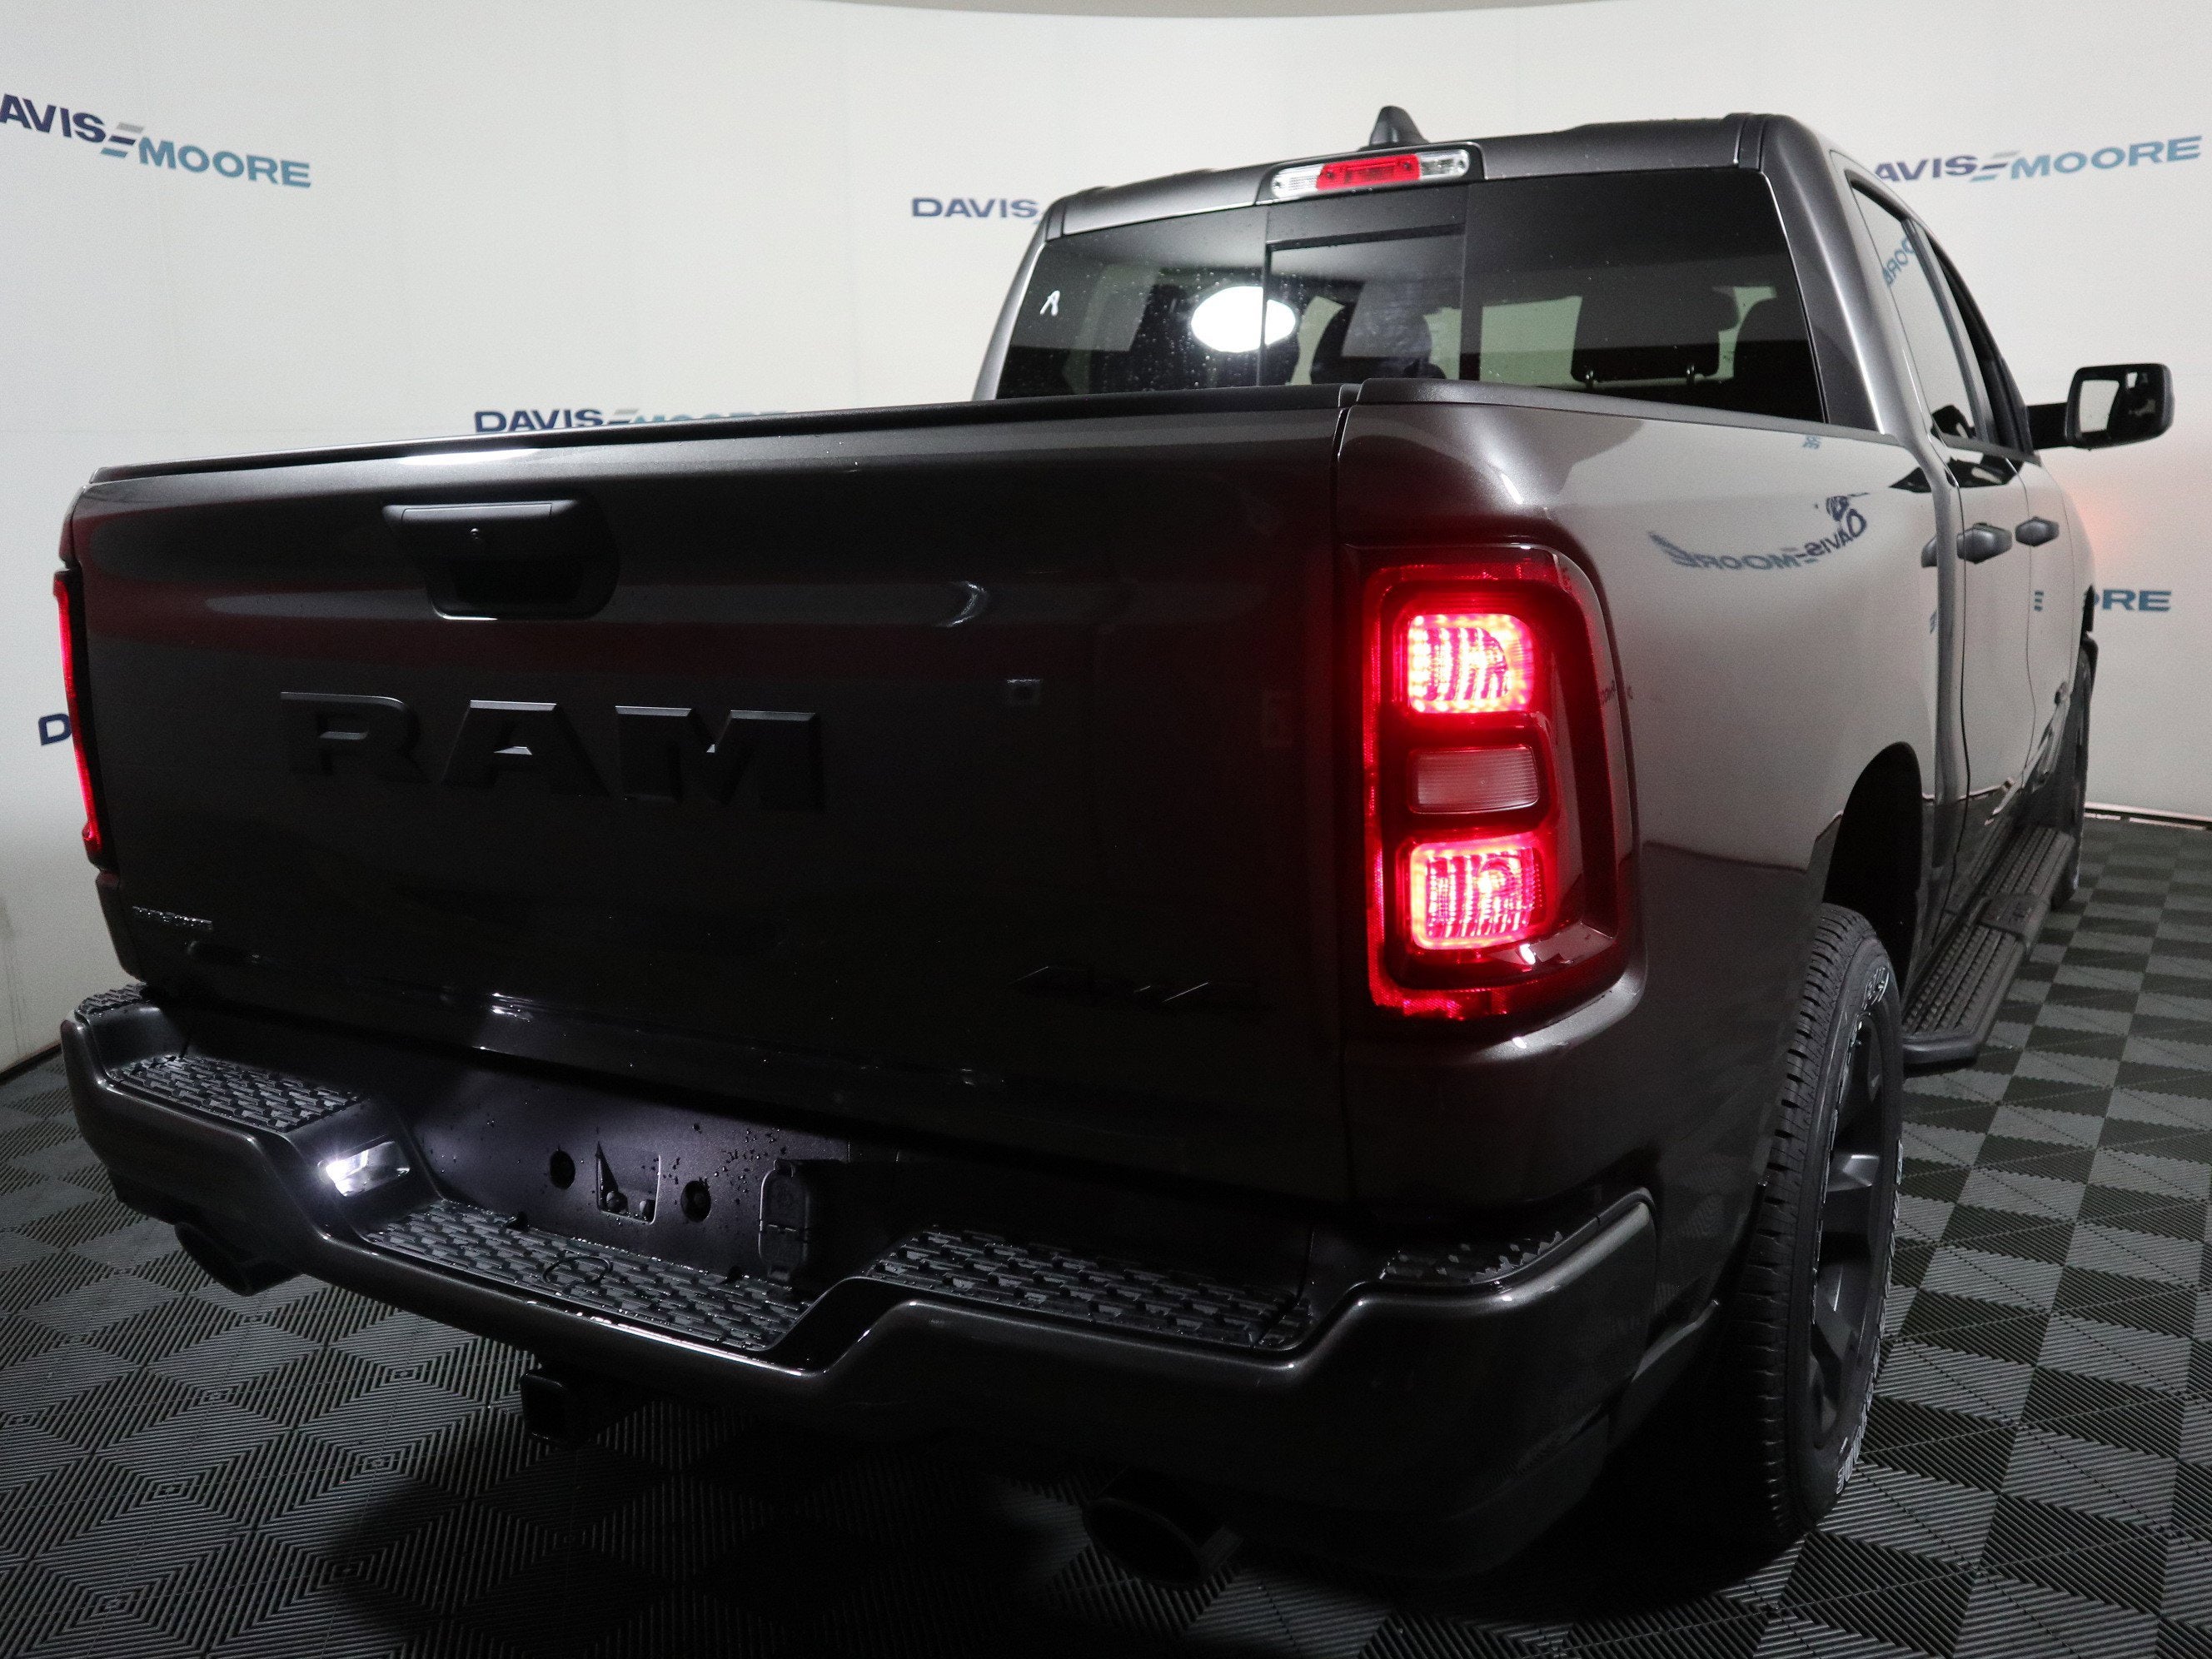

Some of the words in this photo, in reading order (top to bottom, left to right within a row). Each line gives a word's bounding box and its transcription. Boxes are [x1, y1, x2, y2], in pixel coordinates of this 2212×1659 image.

[138, 137, 311, 188] MOORE
[2010, 135, 2203, 181] MOORE
[912, 197, 1039, 218] DAVIS
[475, 407, 603, 433] DAVIS
[281, 690, 825, 813] RAM
